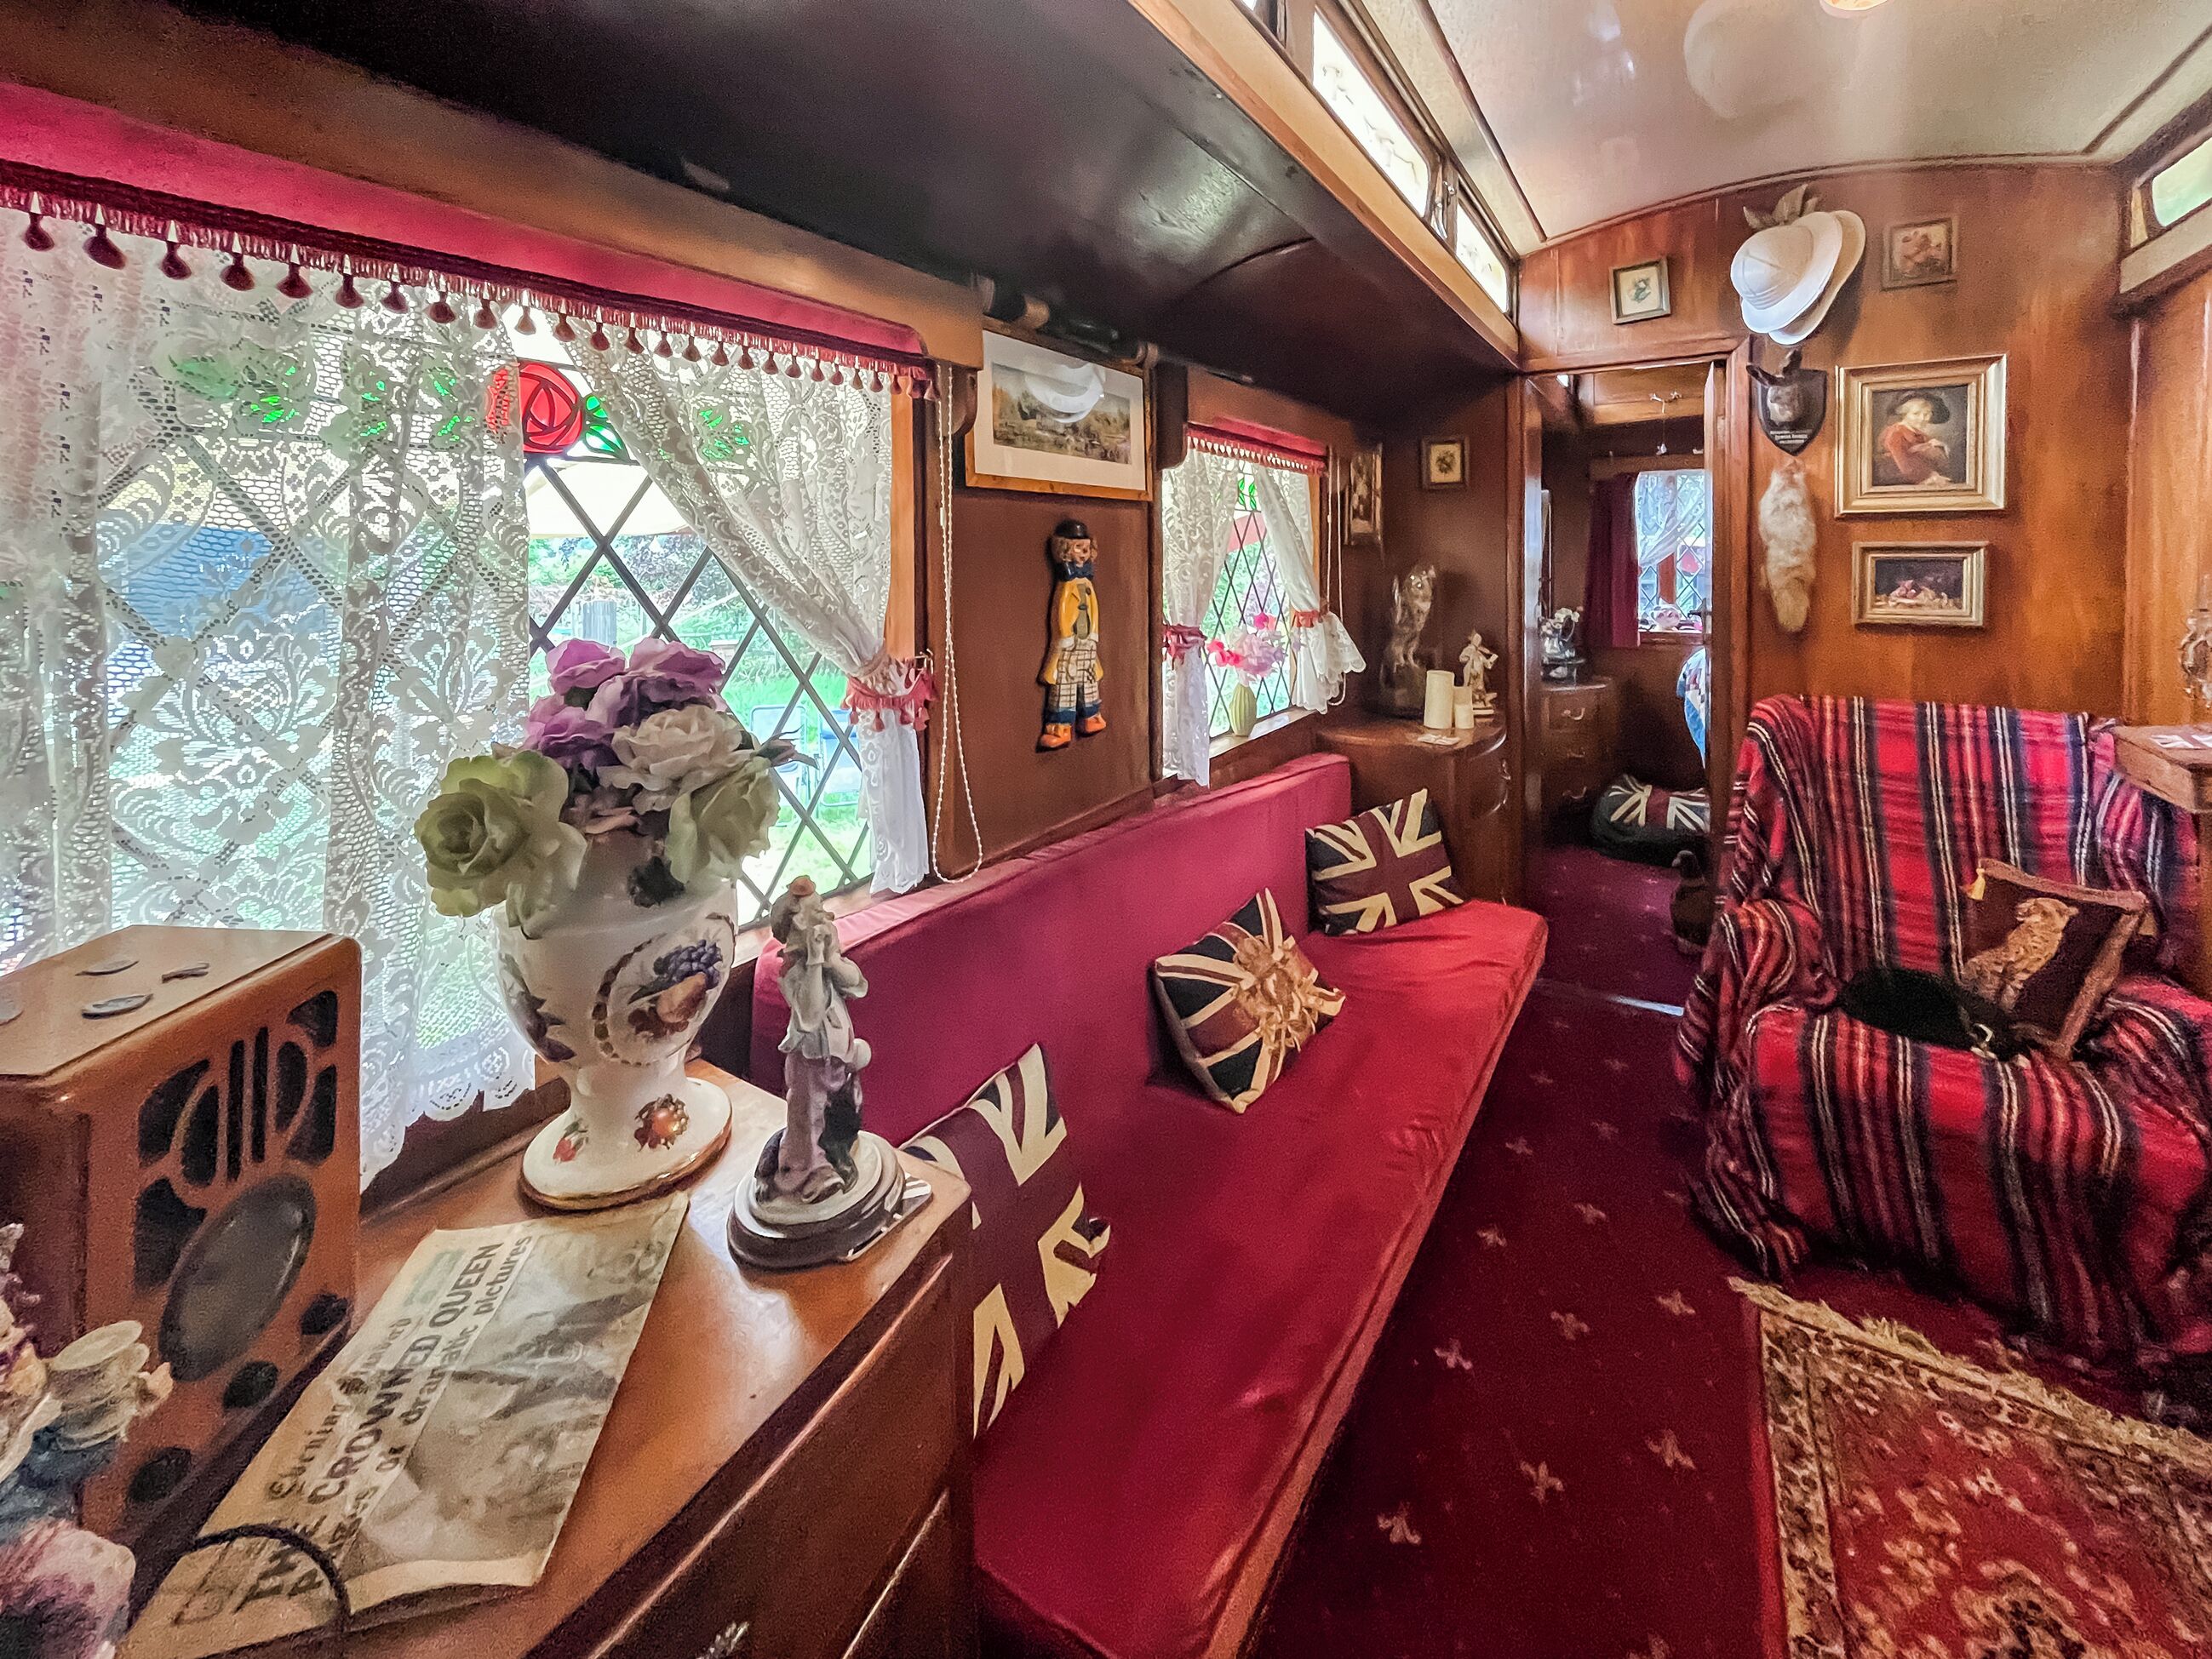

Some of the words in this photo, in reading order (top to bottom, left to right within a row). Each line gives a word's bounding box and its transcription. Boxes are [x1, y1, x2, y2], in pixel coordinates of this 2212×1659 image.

[284, 1485, 382, 1597] Pges
[391, 1323, 481, 1427] dramatic
[463, 1234, 536, 1317] pictures
[301, 1332, 446, 1505] CROWNED
[424, 1242, 505, 1329] QUEEN
